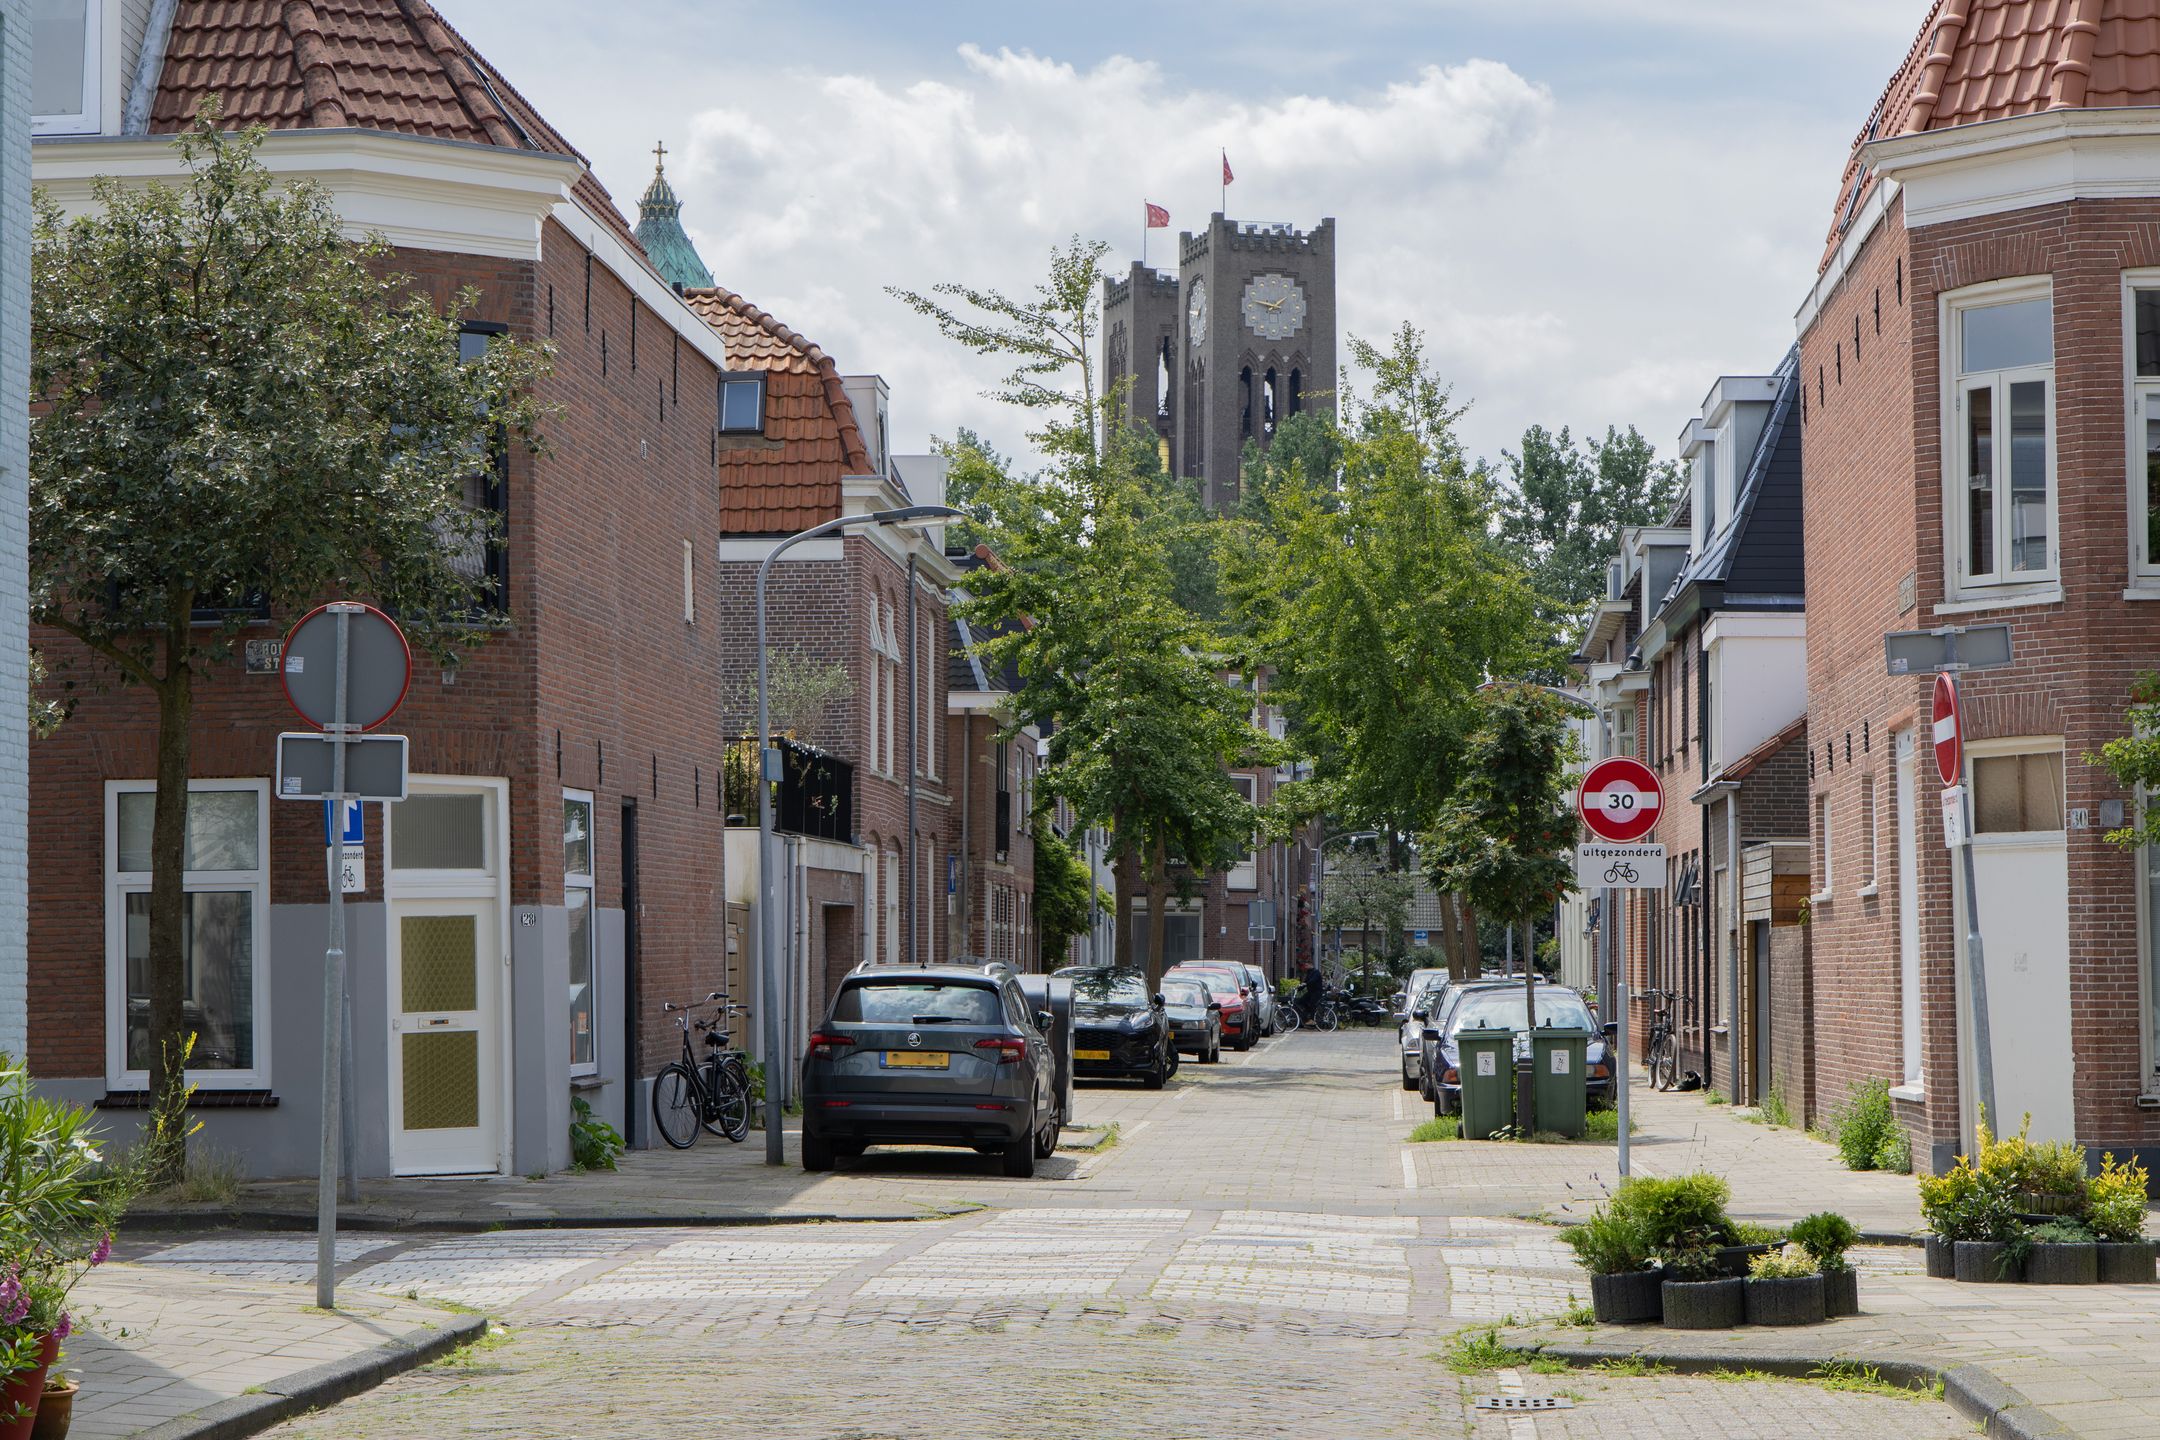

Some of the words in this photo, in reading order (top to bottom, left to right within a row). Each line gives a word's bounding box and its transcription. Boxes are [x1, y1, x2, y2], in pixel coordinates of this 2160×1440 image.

[1608, 793, 1634, 809] 30
[2072, 809, 2087, 827] 30
[1583, 848, 1661, 859] uitgezonderd
